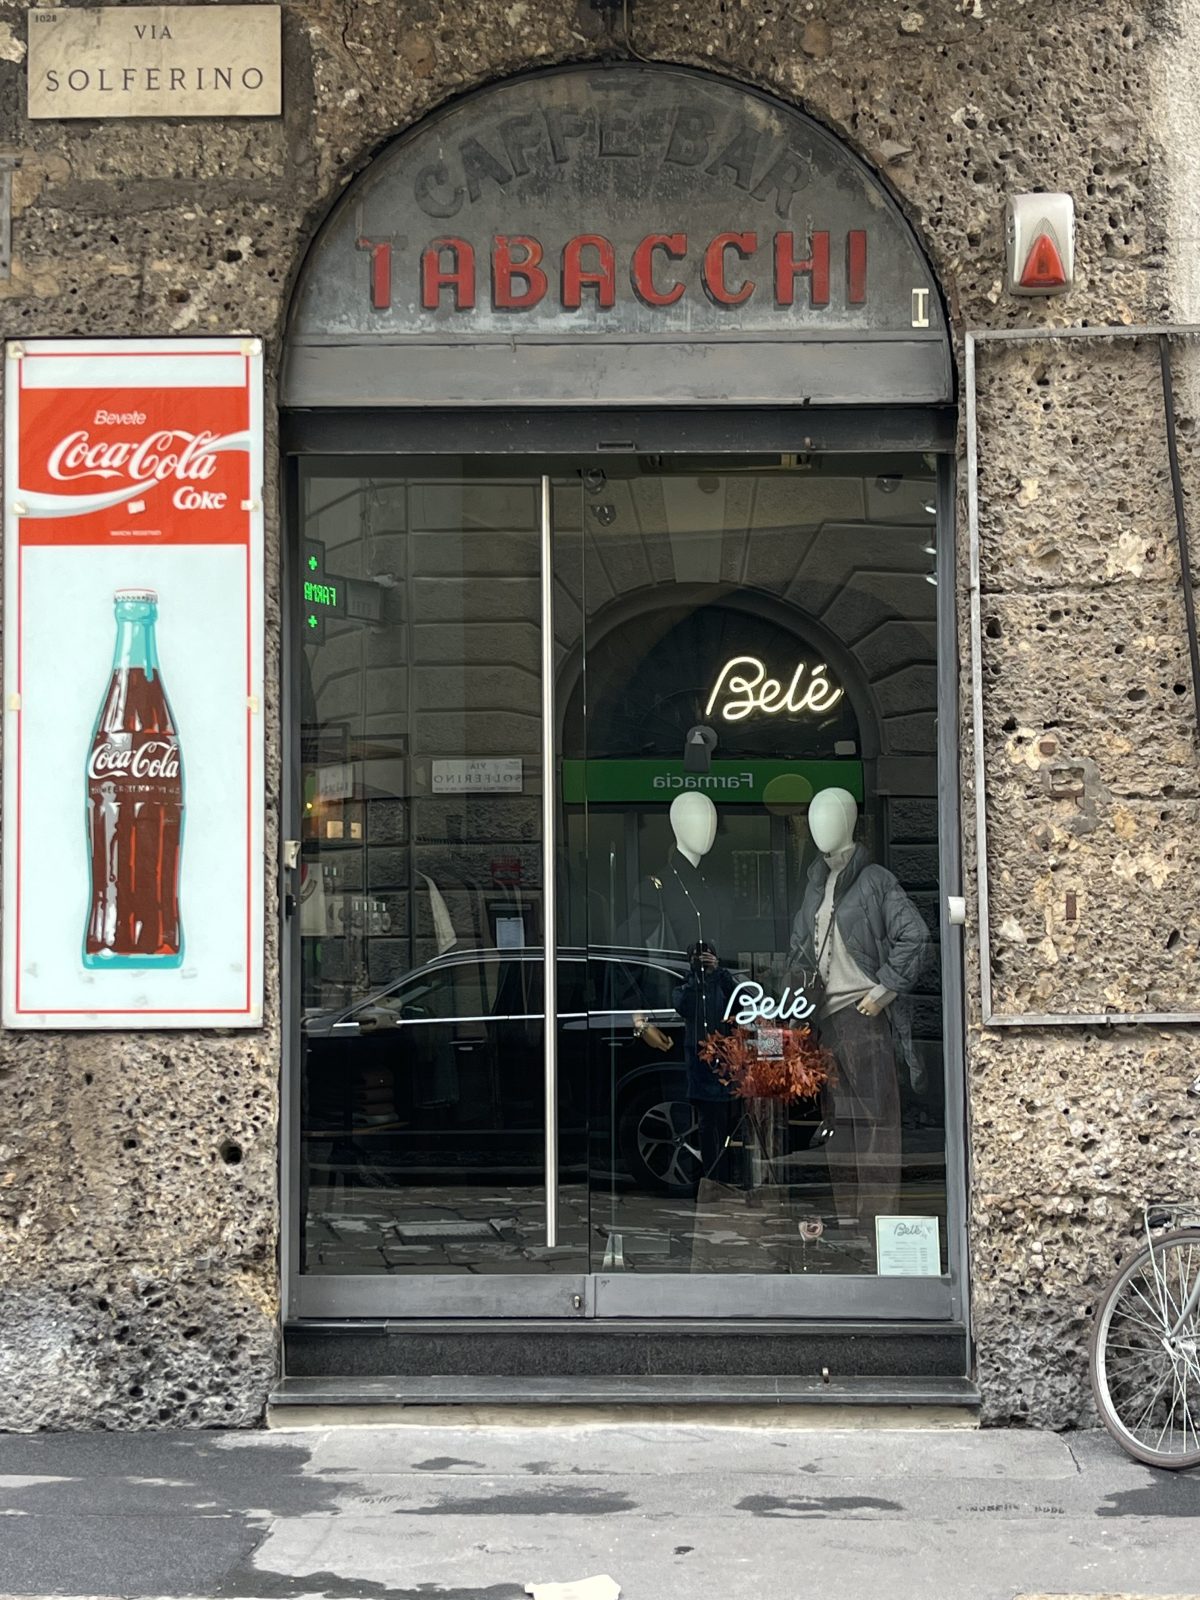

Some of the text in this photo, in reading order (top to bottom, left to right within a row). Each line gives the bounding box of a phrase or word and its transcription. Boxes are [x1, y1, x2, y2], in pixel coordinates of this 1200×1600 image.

[34, 15, 57, 23] 1028
[134, 25, 173, 40] VIA
[46, 68, 264, 92] SOLFERINO
[356, 230, 868, 311] TABACCHI
[93, 410, 147, 425] Bevete
[47, 430, 220, 481] Coca-Cola
[172, 486, 228, 510] Coke
[705, 656, 844, 721] Belé
[88, 741, 180, 779] Coca-Cola
[724, 981, 817, 1025] Belé
